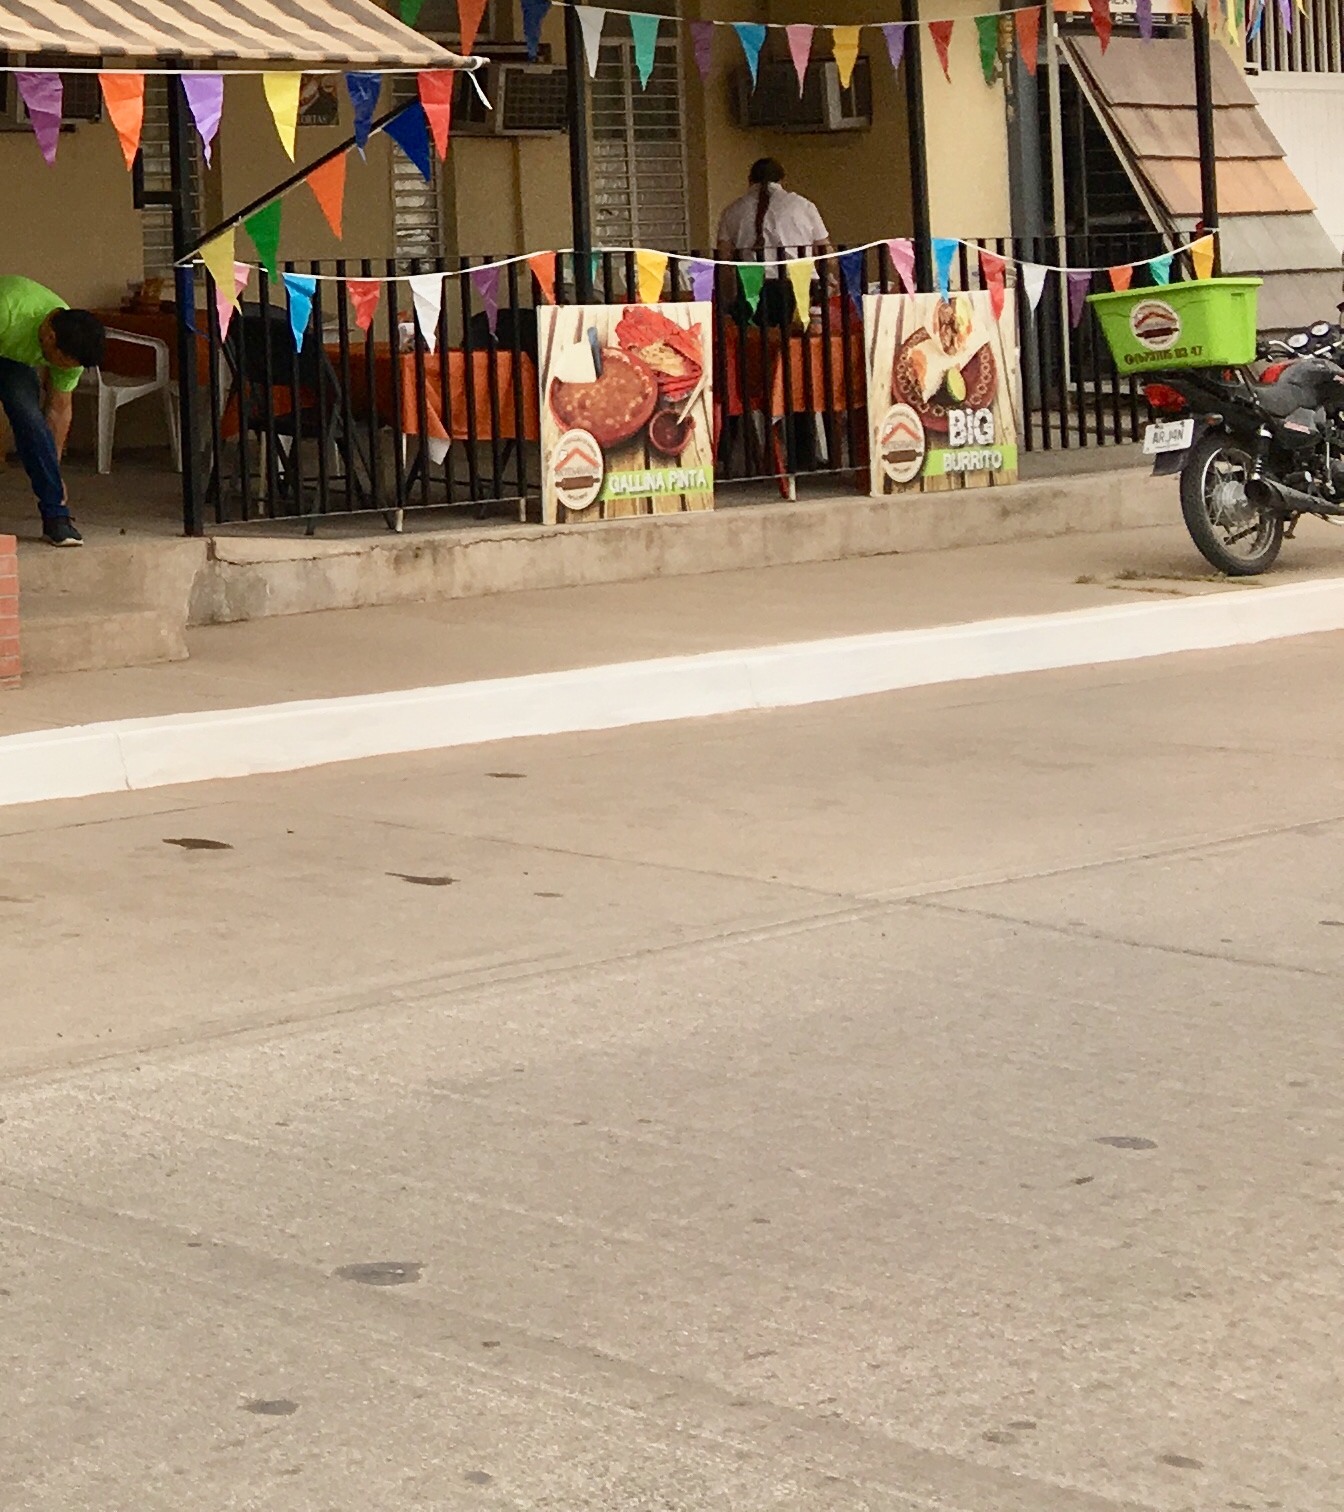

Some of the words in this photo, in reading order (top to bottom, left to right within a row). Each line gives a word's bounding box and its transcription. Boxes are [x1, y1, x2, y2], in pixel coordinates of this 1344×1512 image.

[942, 449, 1004, 473] BURRITO
[607, 471, 666, 496] GALLINA
[667, 468, 710, 492] PINTA
